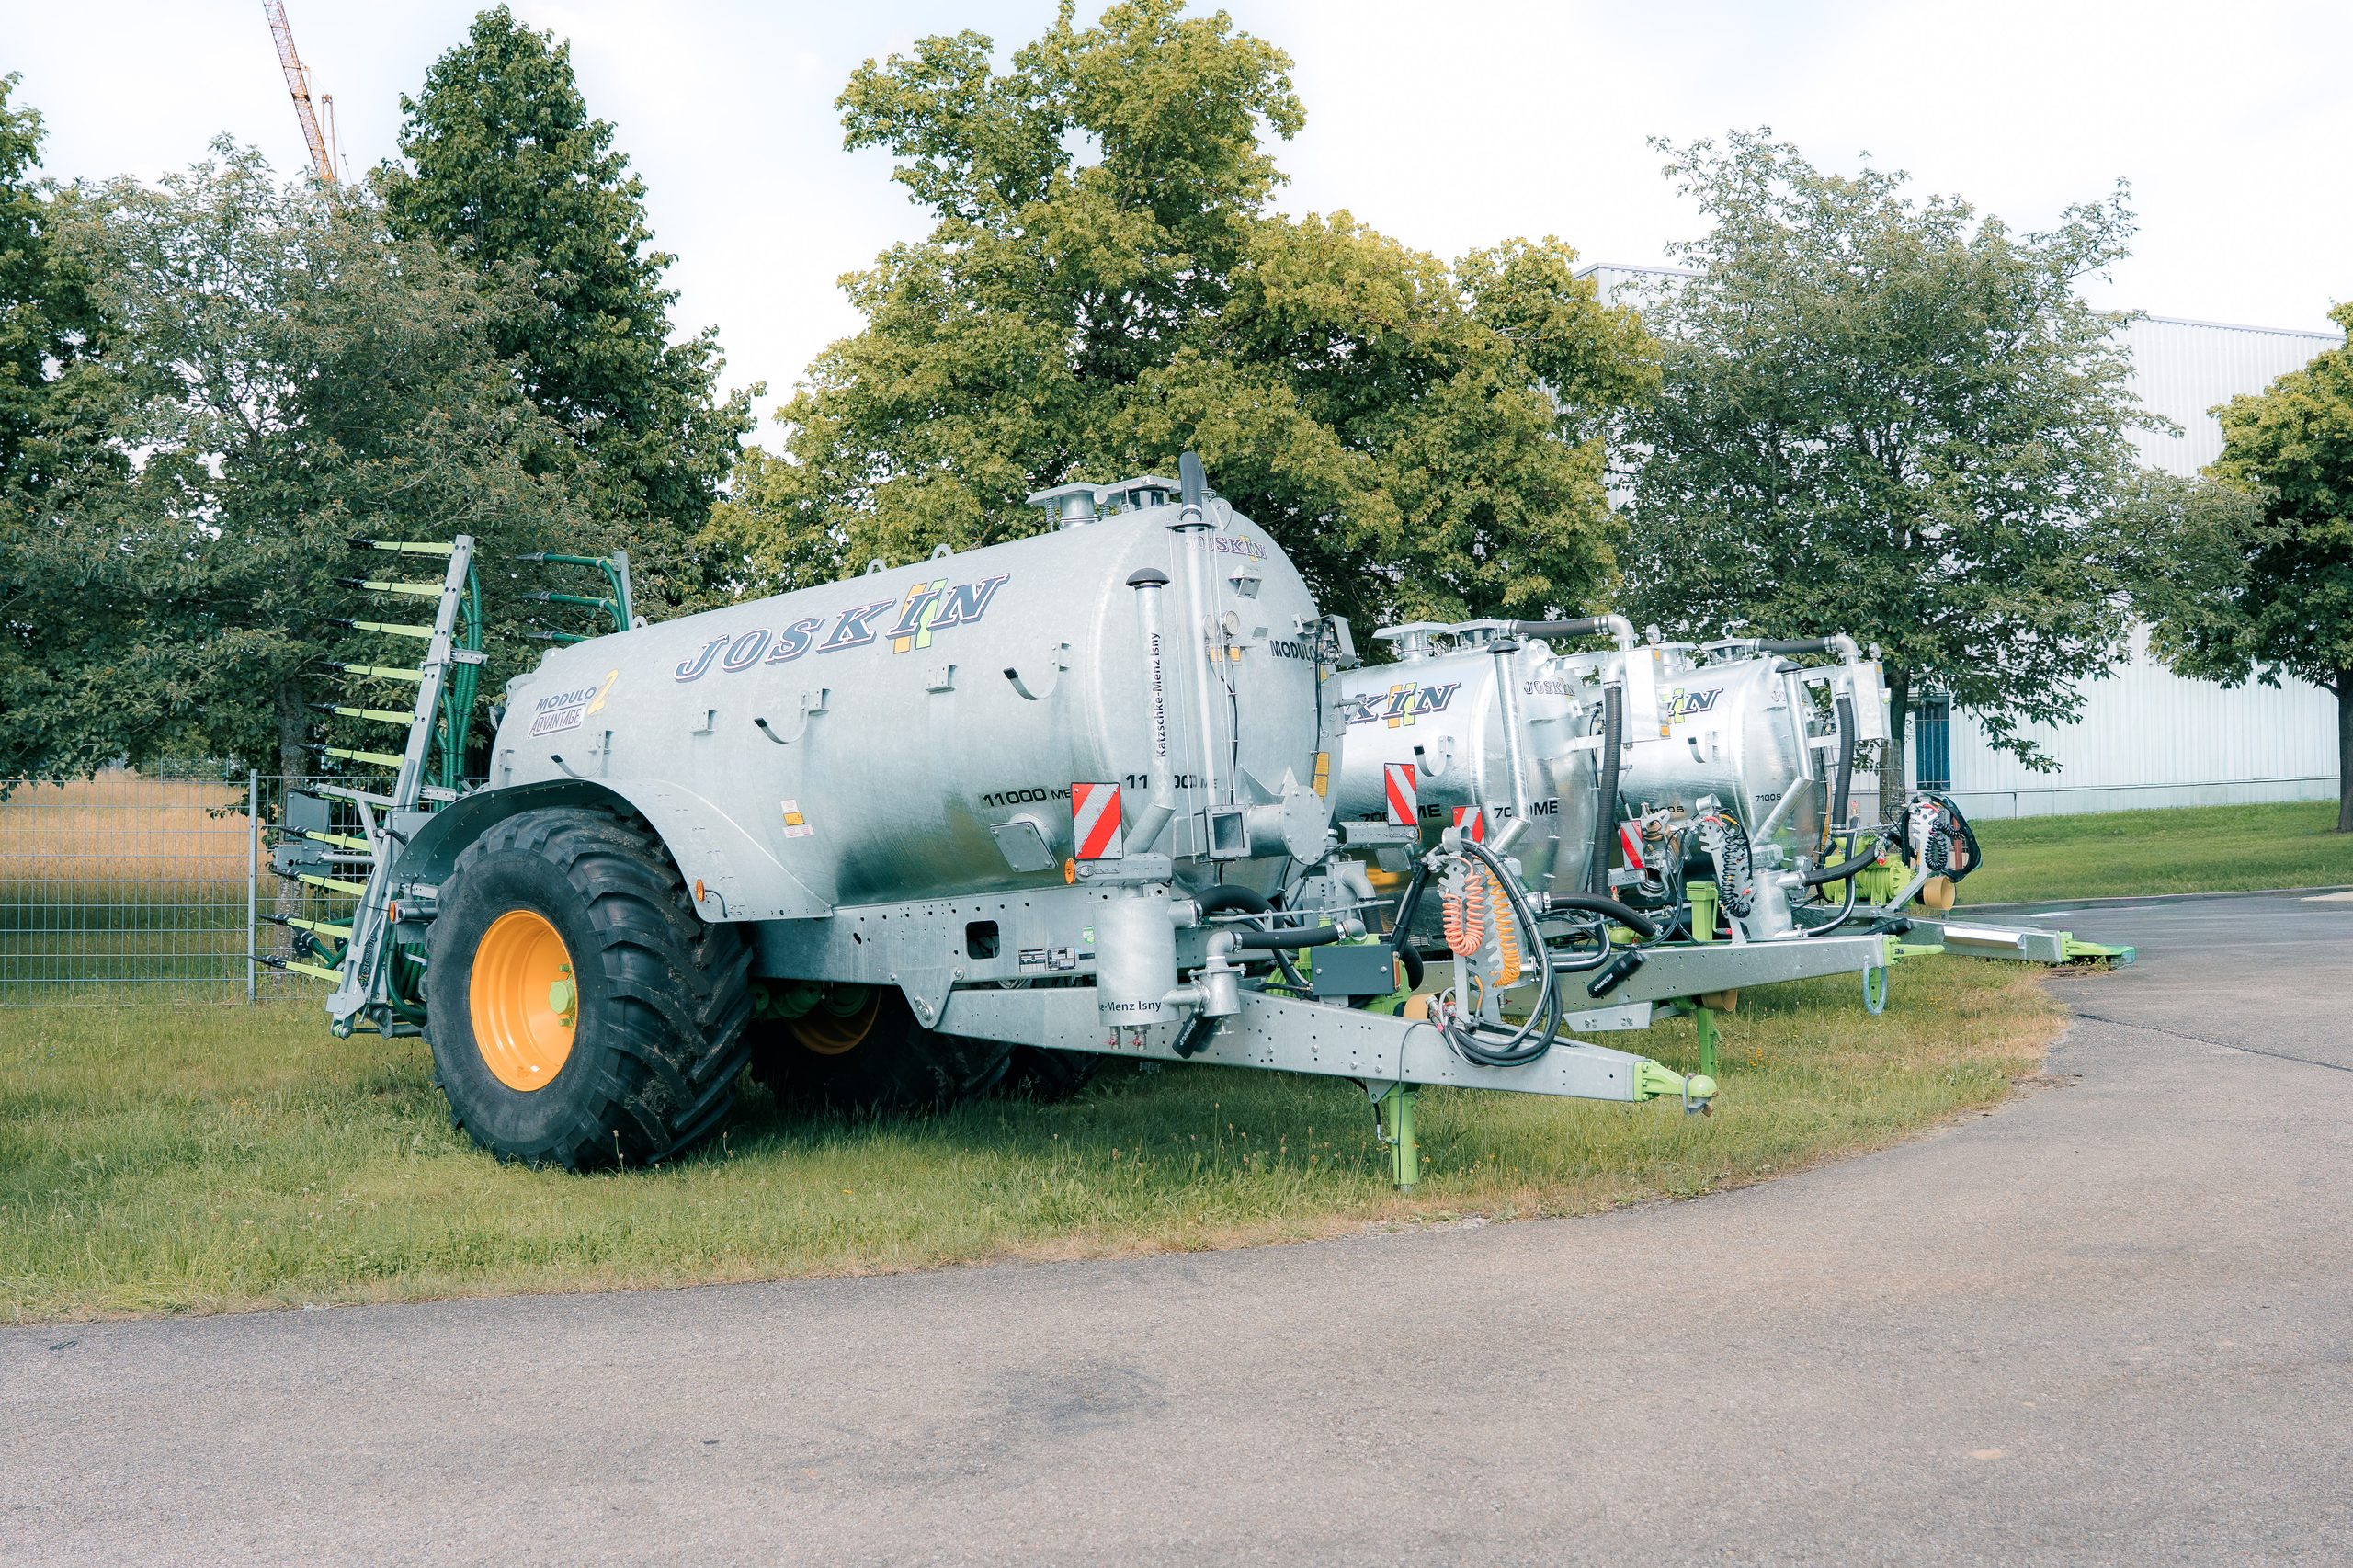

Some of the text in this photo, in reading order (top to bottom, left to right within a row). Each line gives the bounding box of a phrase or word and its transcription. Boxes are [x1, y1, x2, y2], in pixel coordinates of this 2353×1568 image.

[675, 573, 1010, 683] JOSKIN
[535, 668, 619, 715] MODULO 2
[1151, 632, 1166, 757] Katzschke-Menz Isny
[528, 708, 582, 738] ADVANTAGE
[983, 789, 1071, 806] 11000 ME
[1755, 793, 1782, 802] 7100S
[1138, 1000, 1162, 1012] Isny
